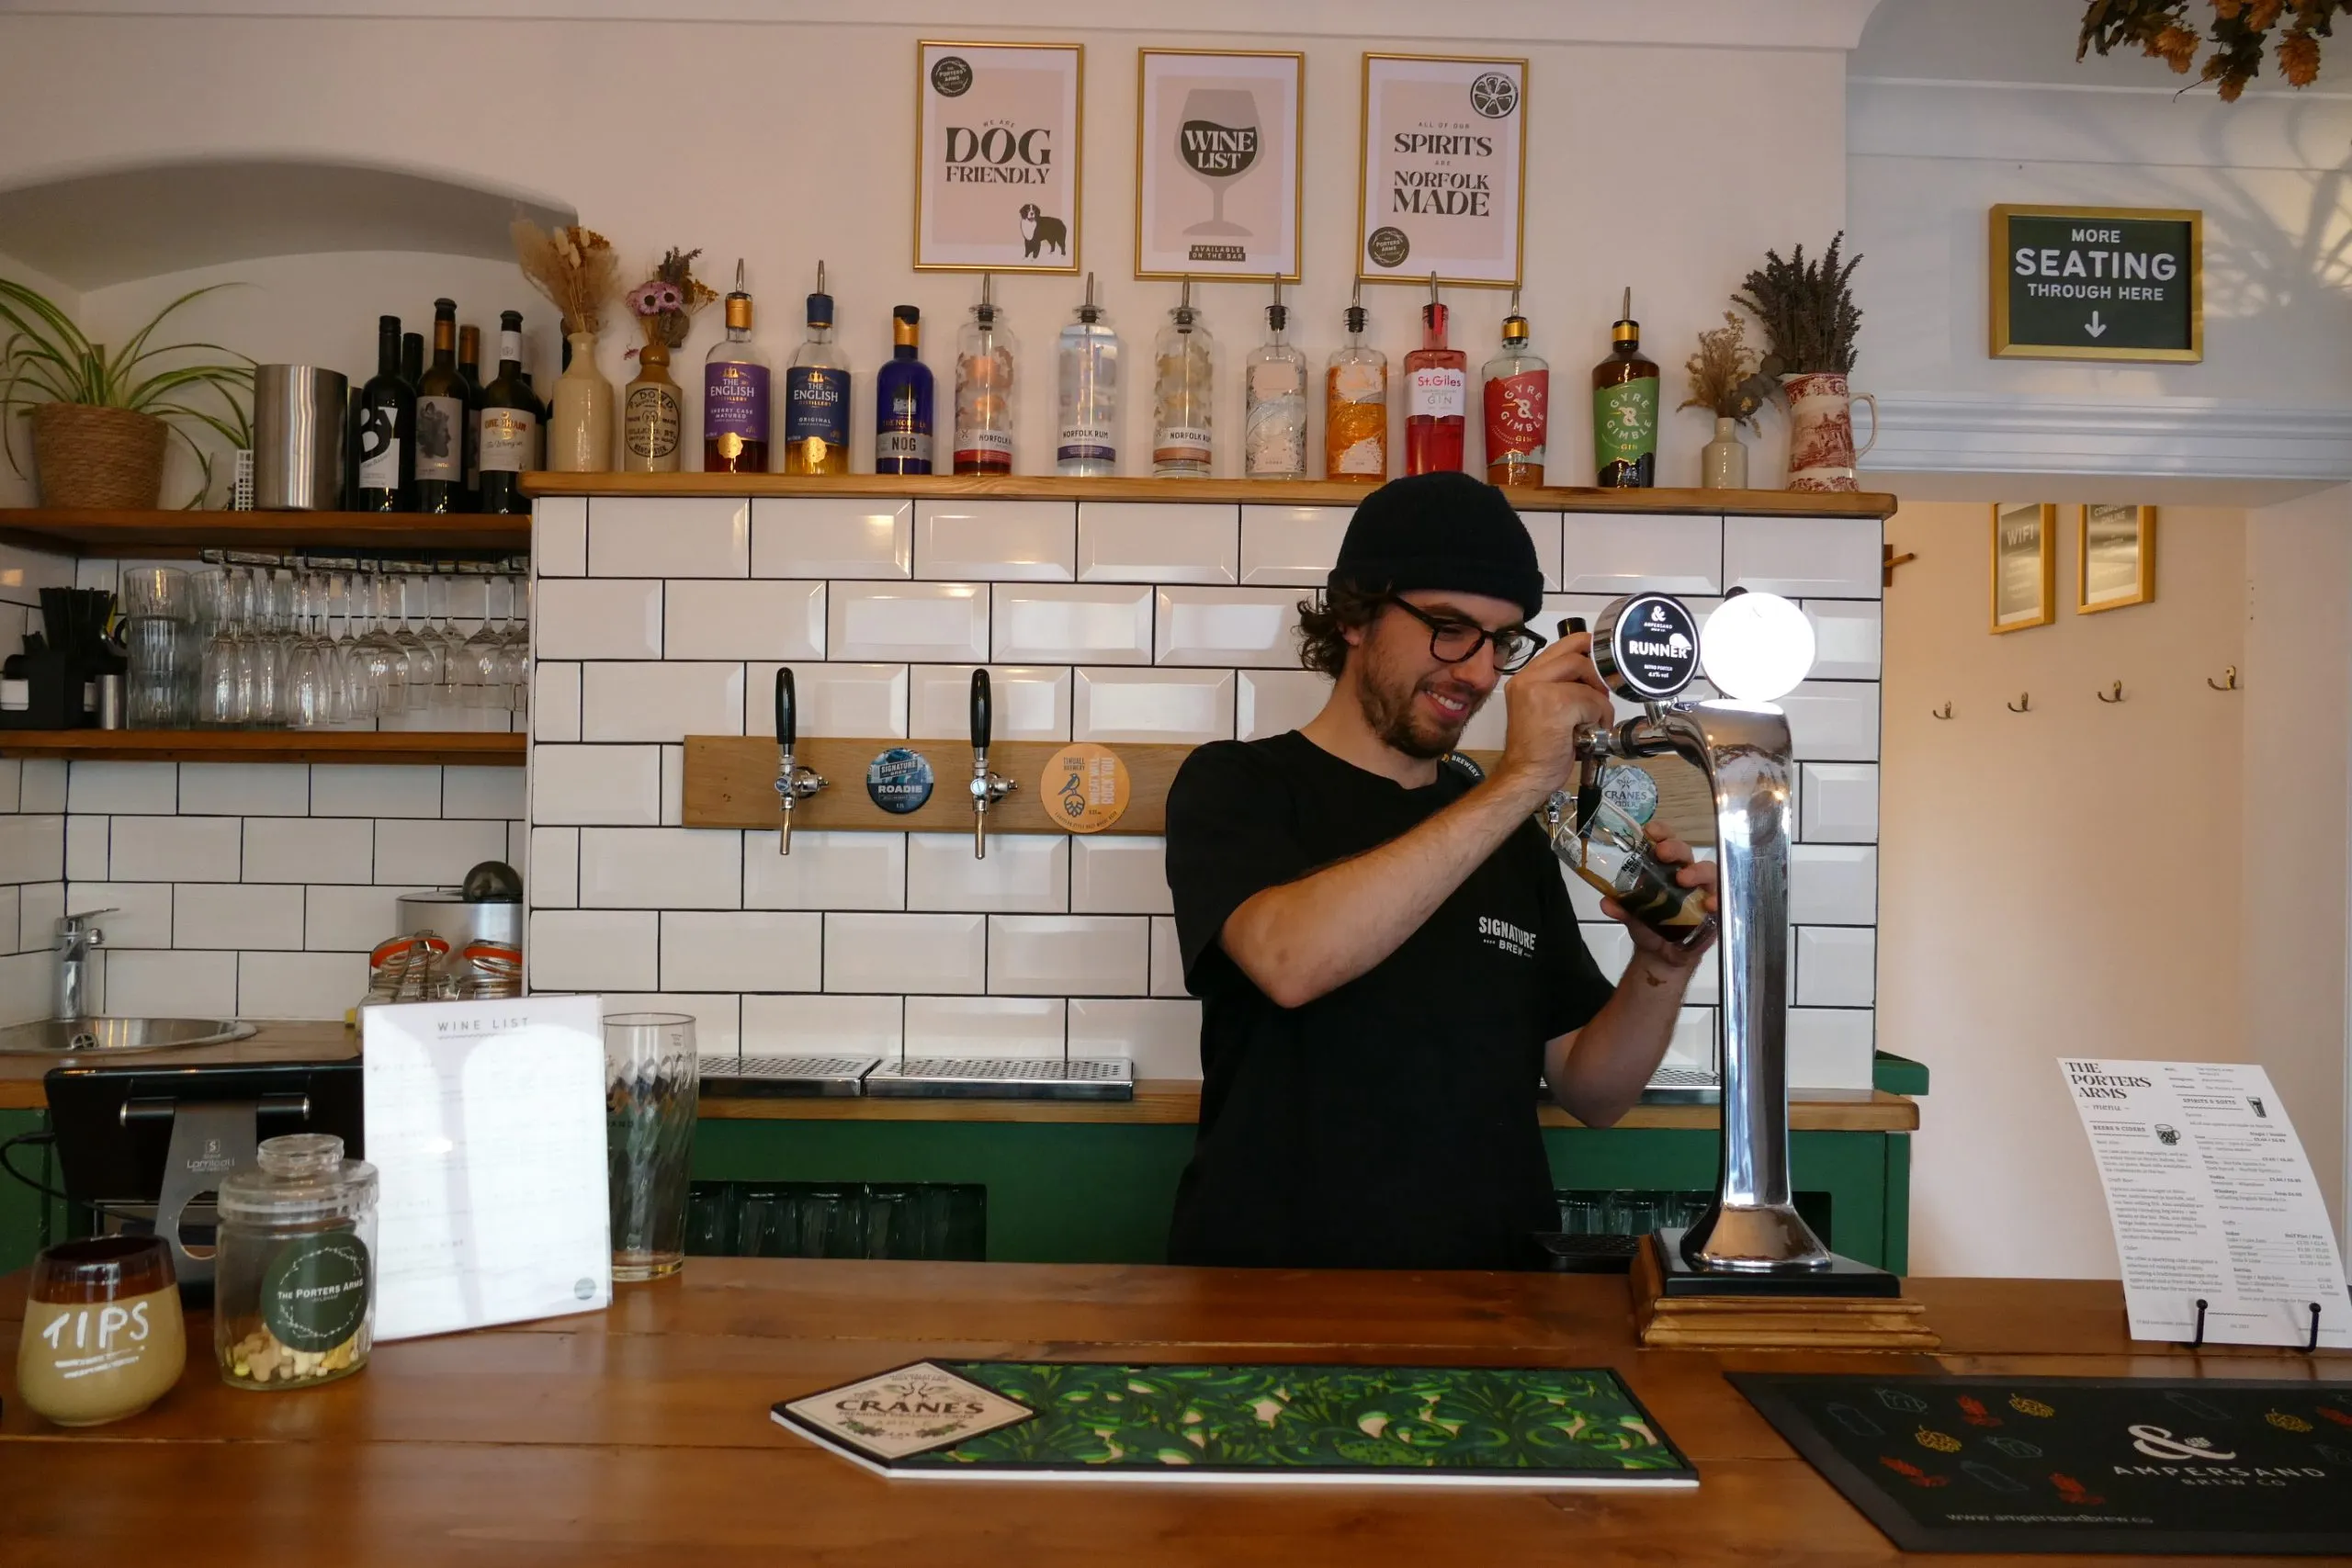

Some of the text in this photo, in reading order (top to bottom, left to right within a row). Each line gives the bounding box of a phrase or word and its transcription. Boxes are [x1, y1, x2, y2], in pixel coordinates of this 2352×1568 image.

[983, 119, 1015, 128] WE ARE
[945, 127, 1051, 165] DOG
[1184, 130, 1255, 152] WINE
[1394, 132, 1493, 157] SPIRITS
[1197, 152, 1241, 169] LIST
[946, 165, 1050, 184] FRIENDLY
[1394, 170, 1490, 190] NORFOLK
[1393, 188, 1490, 217] MADE
[2072, 229, 2120, 243] MORE
[2015, 247, 2177, 281] SEATING
[2027, 283, 2164, 301] THROUGH HERE
[808, 382, 824, 390] THE
[1418, 374, 1462, 387] St.Giles
[710, 386, 754, 398] ENGLISH
[793, 389, 839, 402] ENGLISH
[1427, 395, 1453, 405] GIN
[1504, 384, 1543, 401] GYRE
[1610, 392, 1650, 409] GYRE
[1513, 398, 1533, 420] &
[1617, 407, 1639, 427] &
[1500, 411, 1544, 433] GIMBLE
[1607, 419, 1652, 440] GIMBLE
[978, 434, 1008, 444] NORFOLK
[1062, 430, 1108, 439] NORFOLK RUM
[1170, 432, 1202, 441] NORFOLK
[892, 436, 916, 451] NOG
[1621, 443, 1638, 451] GIN
[1651, 605, 1667, 622] &
[1629, 640, 1689, 660] RUNNER
[881, 760, 917, 773] SIGNATURE
[1452, 755, 1481, 777] BREWERY
[877, 784, 922, 794] ROADIE
[1604, 790, 1647, 801] CRANES
[1478, 916, 1537, 951] SIGNATURE
[1498, 939, 1523, 956] BREW
[437, 1016, 529, 1032] WINE LIST
[2064, 1062, 2102, 1074] THE
[2070, 1074, 2152, 1088] PORTERS
[2078, 1087, 2128, 1100] ARMS
[277, 1278, 364, 1300] THE PORTERS ARMS
[42, 1301, 150, 1350] TIPS
[835, 1399, 985, 1416] CRANES
[2127, 1425, 2237, 1461] &
[2113, 1465, 2325, 1477] AMPERSAND
[2180, 1478, 2287, 1487] BREW CO
